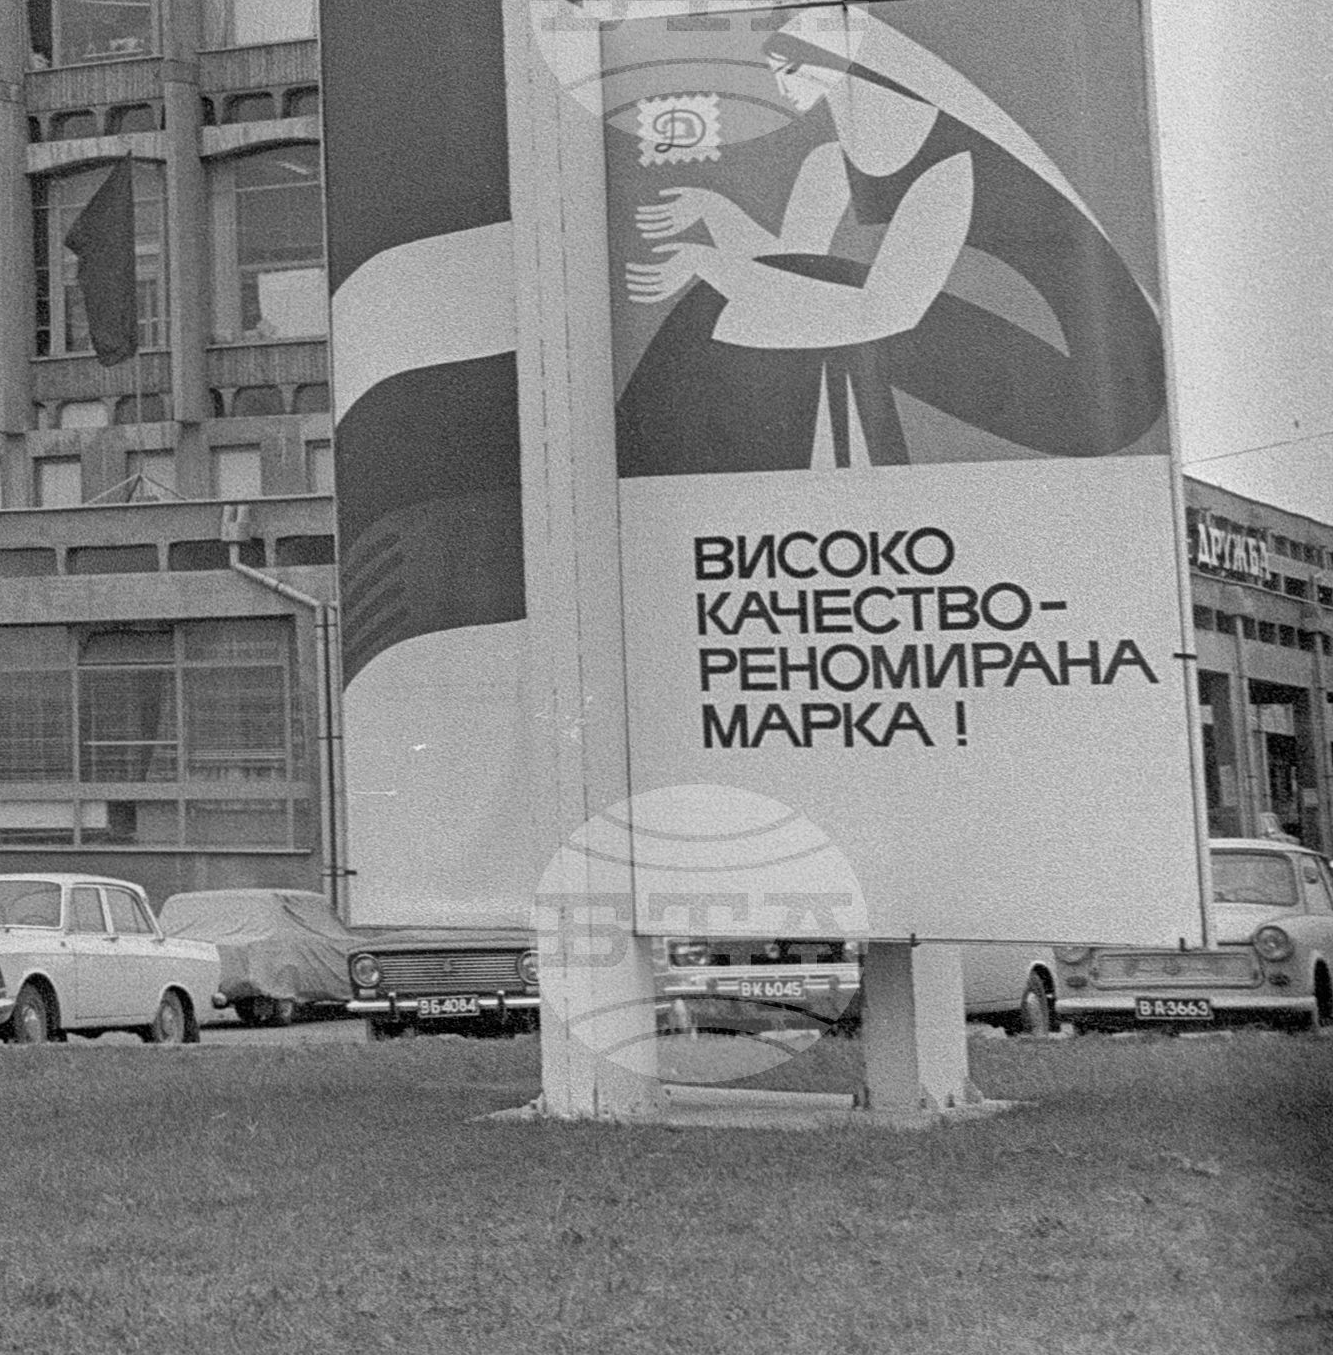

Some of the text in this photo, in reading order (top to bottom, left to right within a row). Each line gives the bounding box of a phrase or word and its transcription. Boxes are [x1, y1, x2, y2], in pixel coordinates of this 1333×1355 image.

[694, 527, 955, 581] ВИСОКО
[1197, 523, 1271, 580] ДРУЖБА
[699, 639, 1160, 692] РЕНОМИРАНА
